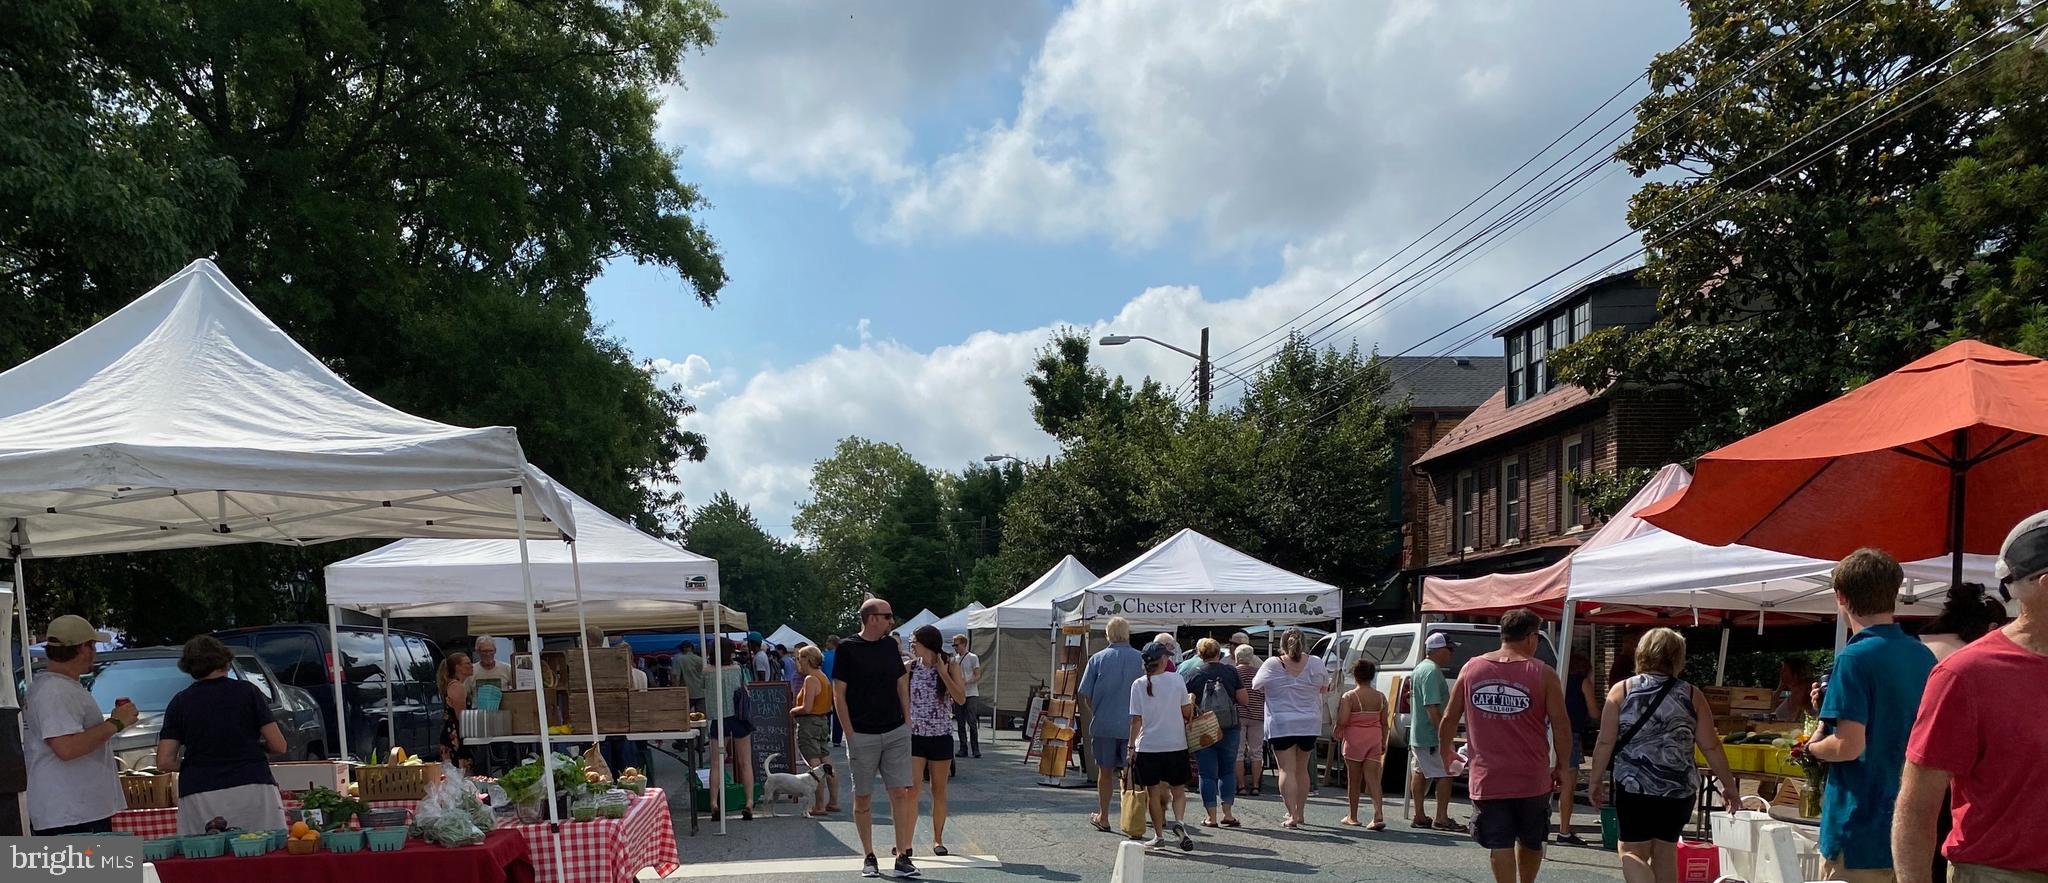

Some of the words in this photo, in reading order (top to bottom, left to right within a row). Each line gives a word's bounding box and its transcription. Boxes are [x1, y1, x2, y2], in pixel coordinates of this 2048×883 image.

[1123, 598, 1186, 614] Chester
[1191, 598, 1237, 614] River
[1241, 598, 1297, 614] Aronia
